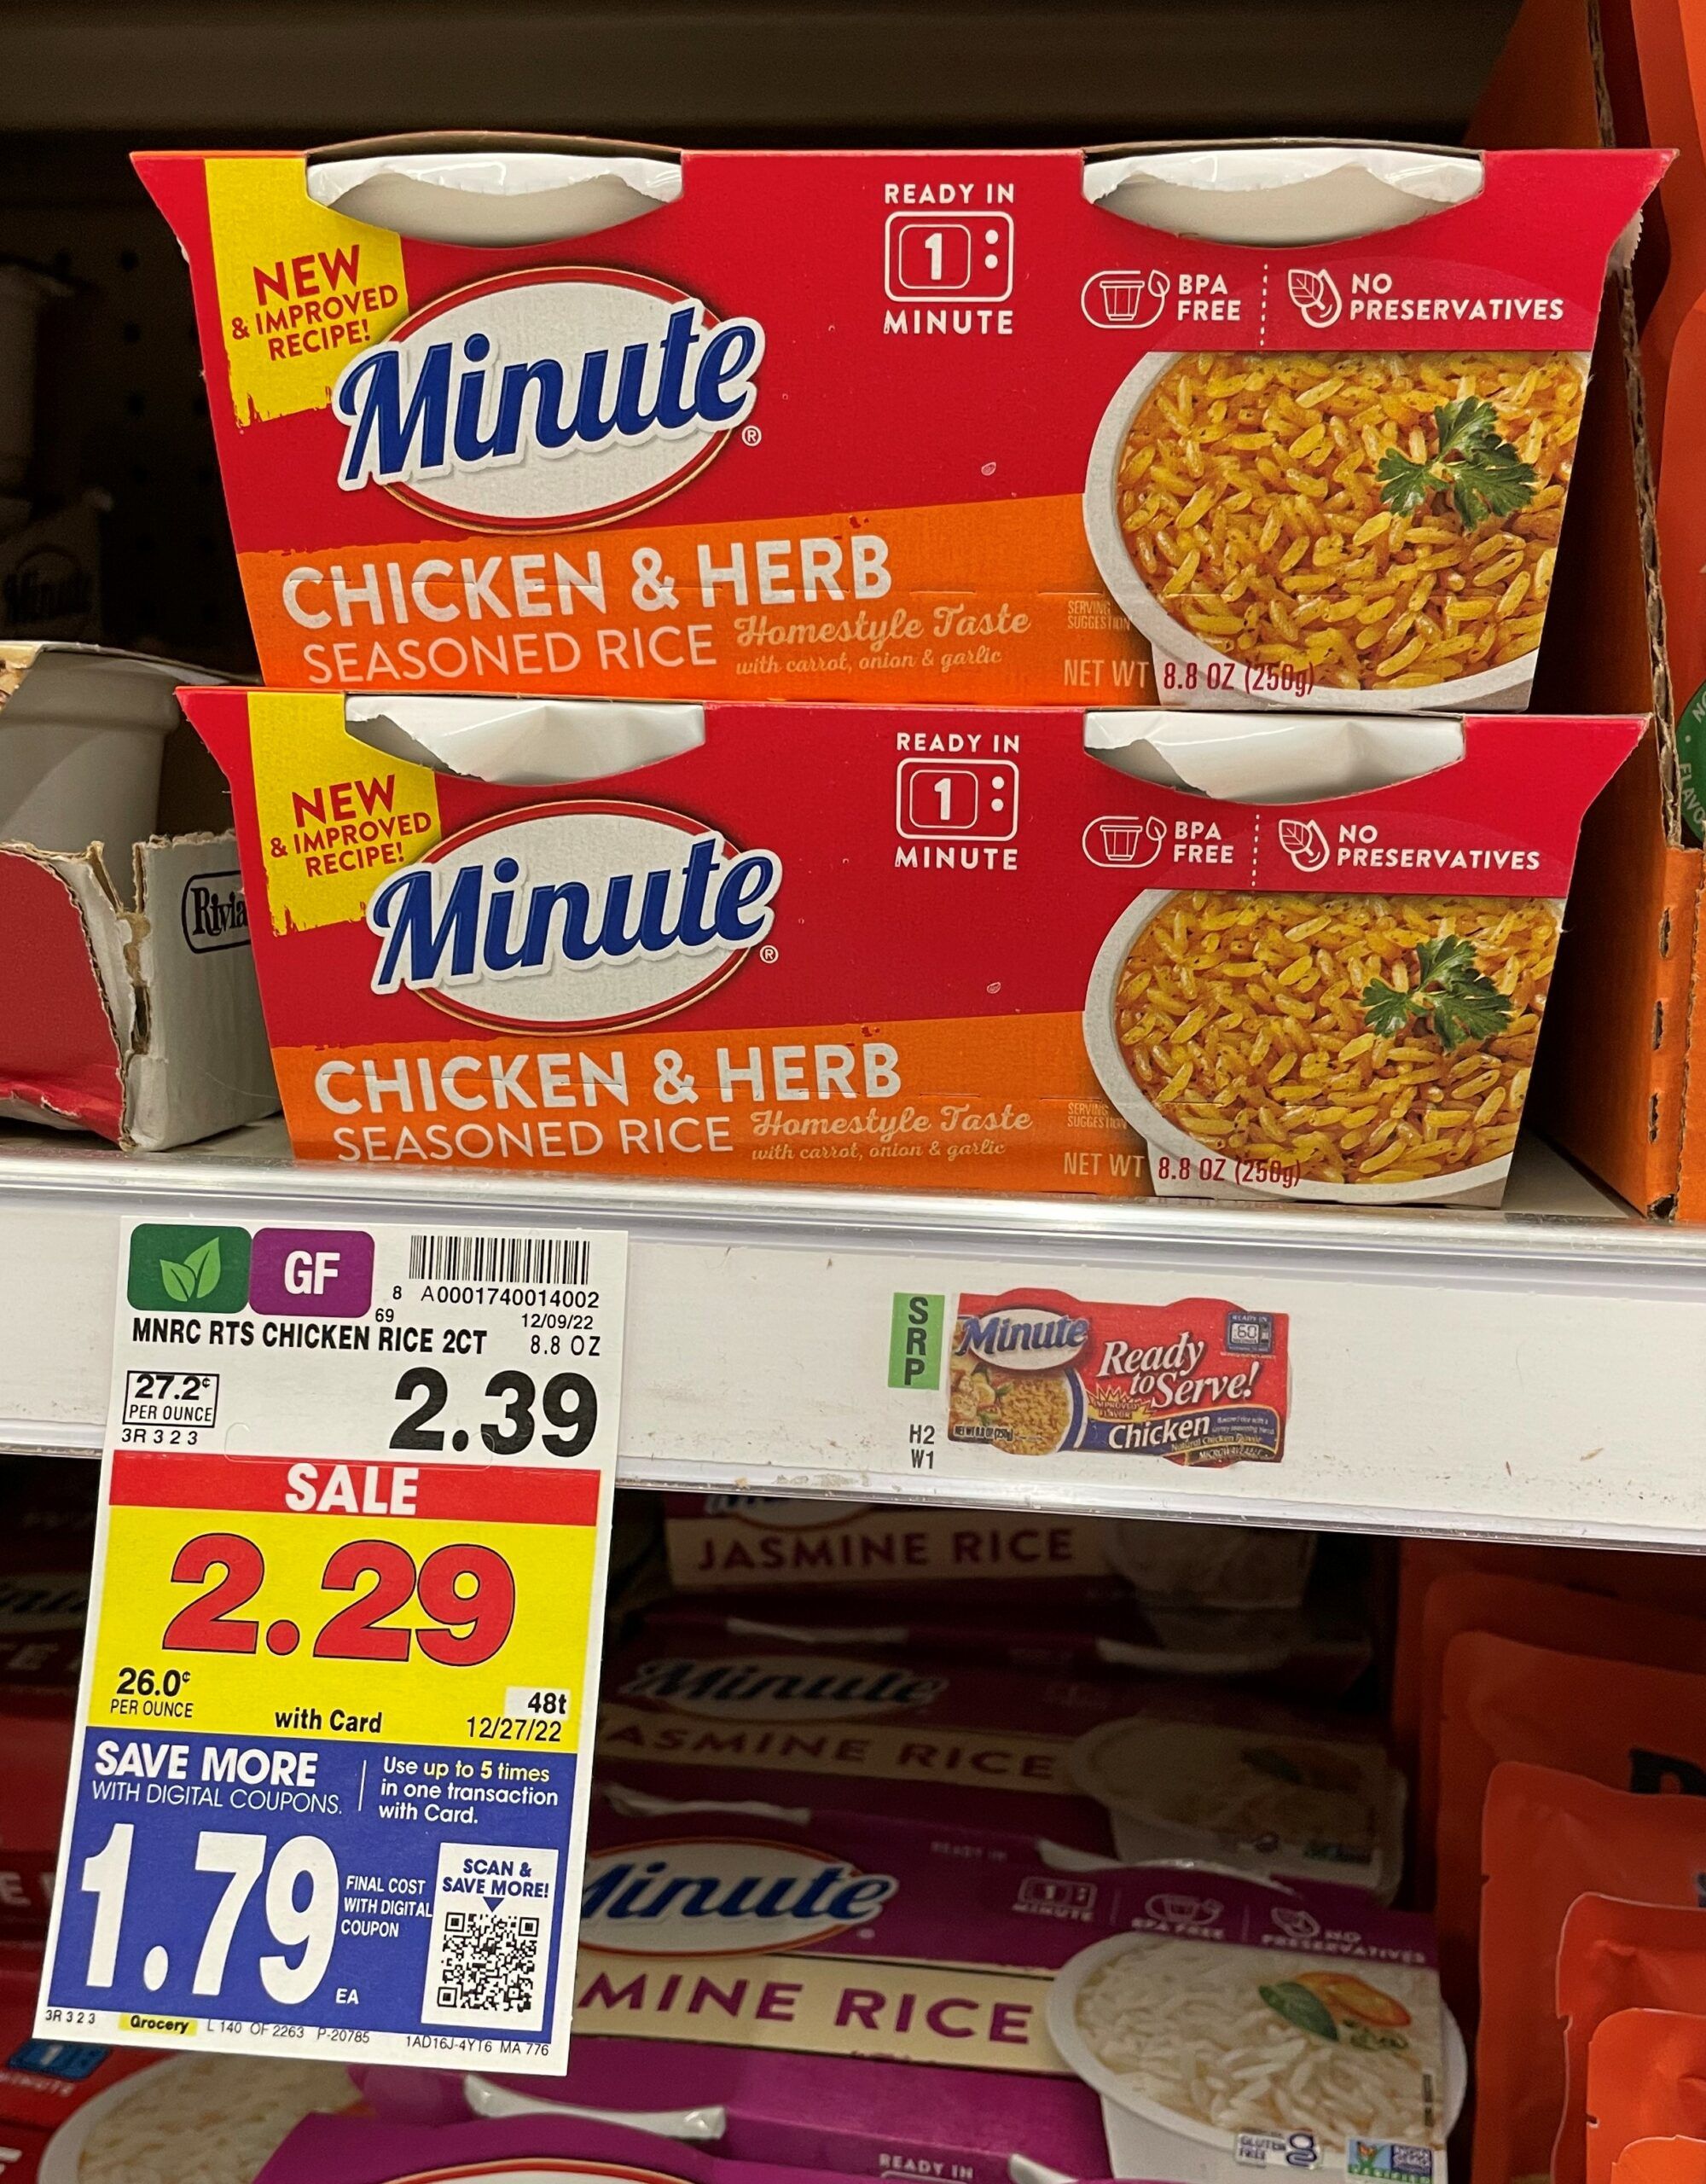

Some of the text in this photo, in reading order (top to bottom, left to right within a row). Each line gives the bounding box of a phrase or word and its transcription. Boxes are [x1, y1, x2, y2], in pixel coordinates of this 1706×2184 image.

[885, 183, 1015, 205] READY IN
[924, 233, 942, 281] 1
[252, 245, 361, 306] NEW
[1178, 274, 1228, 294] BPA
[1352, 274, 1393, 294] NO
[231, 283, 398, 340] & IMPROVED
[883, 311, 1013, 334] MINUTE
[1177, 300, 1240, 322] FREE
[1349, 299, 1564, 322] PRESERVATIVES
[268, 320, 371, 361] RECIPE!
[339, 306, 756, 481] Minute
[282, 535, 891, 628] CHICKEN & HERB
[1068, 601, 1111, 614] SERVING
[734, 603, 1031, 652] Homestyle Taste
[1068, 614, 1131, 630] SUGGESTION
[304, 624, 717, 684] SEASONED RICE
[735, 646, 1002, 675] with carrot, onion & garlic
[1064, 659, 1314, 697] NET WT 8.8 OZ (250g)
[896, 733, 1020, 753] READY IN
[291, 774, 397, 828] NEW
[935, 778, 951, 821] 1
[270, 812, 432, 858] & IMPROVED
[1175, 822, 1222, 841] BPA
[1338, 825, 1378, 845] NO
[305, 844, 405, 878] RECIPE!
[895, 848, 1018, 870] MINUTE
[1173, 845, 1234, 865] FREE
[1337, 849, 1541, 872] PRESERVATIVES
[193, 887, 247, 935] Rivia
[374, 837, 772, 985] Minute
[315, 1043, 901, 1114] CHICKEN & HERB
[1067, 1102, 1109, 1116] SERVING
[750, 1104, 1033, 1144] Homestyle Taste
[1067, 1115, 1127, 1130] SUGGESTION
[334, 1116, 734, 1163] SEASONED RICE
[752, 1139, 1006, 1161] with carrot, onion & garlic
[1064, 1152, 1301, 1188] NET WT 8.8 OZ (250g)
[284, 1251, 340, 1296] GF
[392, 1286, 600, 1310] 8 A0001740014002
[375, 1309, 394, 1323] 69
[522, 1313, 594, 1331] 12/09/22
[132, 1318, 487, 1356] MNRC RTS CHICKEN RICE 2CT
[530, 1334, 601, 1357] 8.8 OZ
[955, 1316, 1089, 1356] Minute
[1096, 1331, 1205, 1379] Ready
[1130, 1361, 1260, 1410] to Serve!
[129, 1404, 213, 1423] PER OUNCE
[389, 1366, 598, 1459] 2.39
[121, 1428, 147, 1444] 3R
[908, 1424, 935, 1445] H2
[1109, 1415, 1210, 1449] Chicken
[911, 1449, 935, 1470] W1
[286, 1463, 420, 1516] SALE
[699, 1529, 1073, 1571] JASMINE RICE
[161, 1532, 516, 1667] 2.29
[621, 1657, 947, 1703] Minute
[110, 1699, 194, 1719] PER OUNCE
[528, 1692, 567, 1715] 48t
[275, 1709, 383, 1734] with Card
[466, 1717, 562, 1742] 12/27/22
[95, 1740, 319, 1789] SAVE MORE
[607, 1725, 1056, 1779] ASMINE RICE
[383, 1757, 550, 1783] Use up to 5 times
[92, 1781, 343, 1815] WITH DIGITAL COUPONS.
[380, 1778, 560, 1807] in one transaction
[379, 1801, 479, 1826] with Card.
[462, 1858, 532, 1877] SCAN &
[345, 1875, 426, 1896] FINAL COST
[443, 1874, 550, 1899] SAVE MORE!
[81, 1822, 339, 2006] 1.79
[344, 1897, 433, 1919] WITH DIGITAL
[341, 1920, 400, 1938] COUPON
[1262, 1934, 1426, 1963] PRESERVATIVES
[336, 1988, 360, 2005] EA
[577, 1972, 1033, 2045] MINE RICE
[130, 2014, 190, 2036] Grocery
[206, 2018, 370, 2044] L 140 OF 2263 P-20785
[501, 2041, 522, 2054] MA
[527, 2042, 549, 2056] 776
[879, 2153, 972, 2179] READY IN
